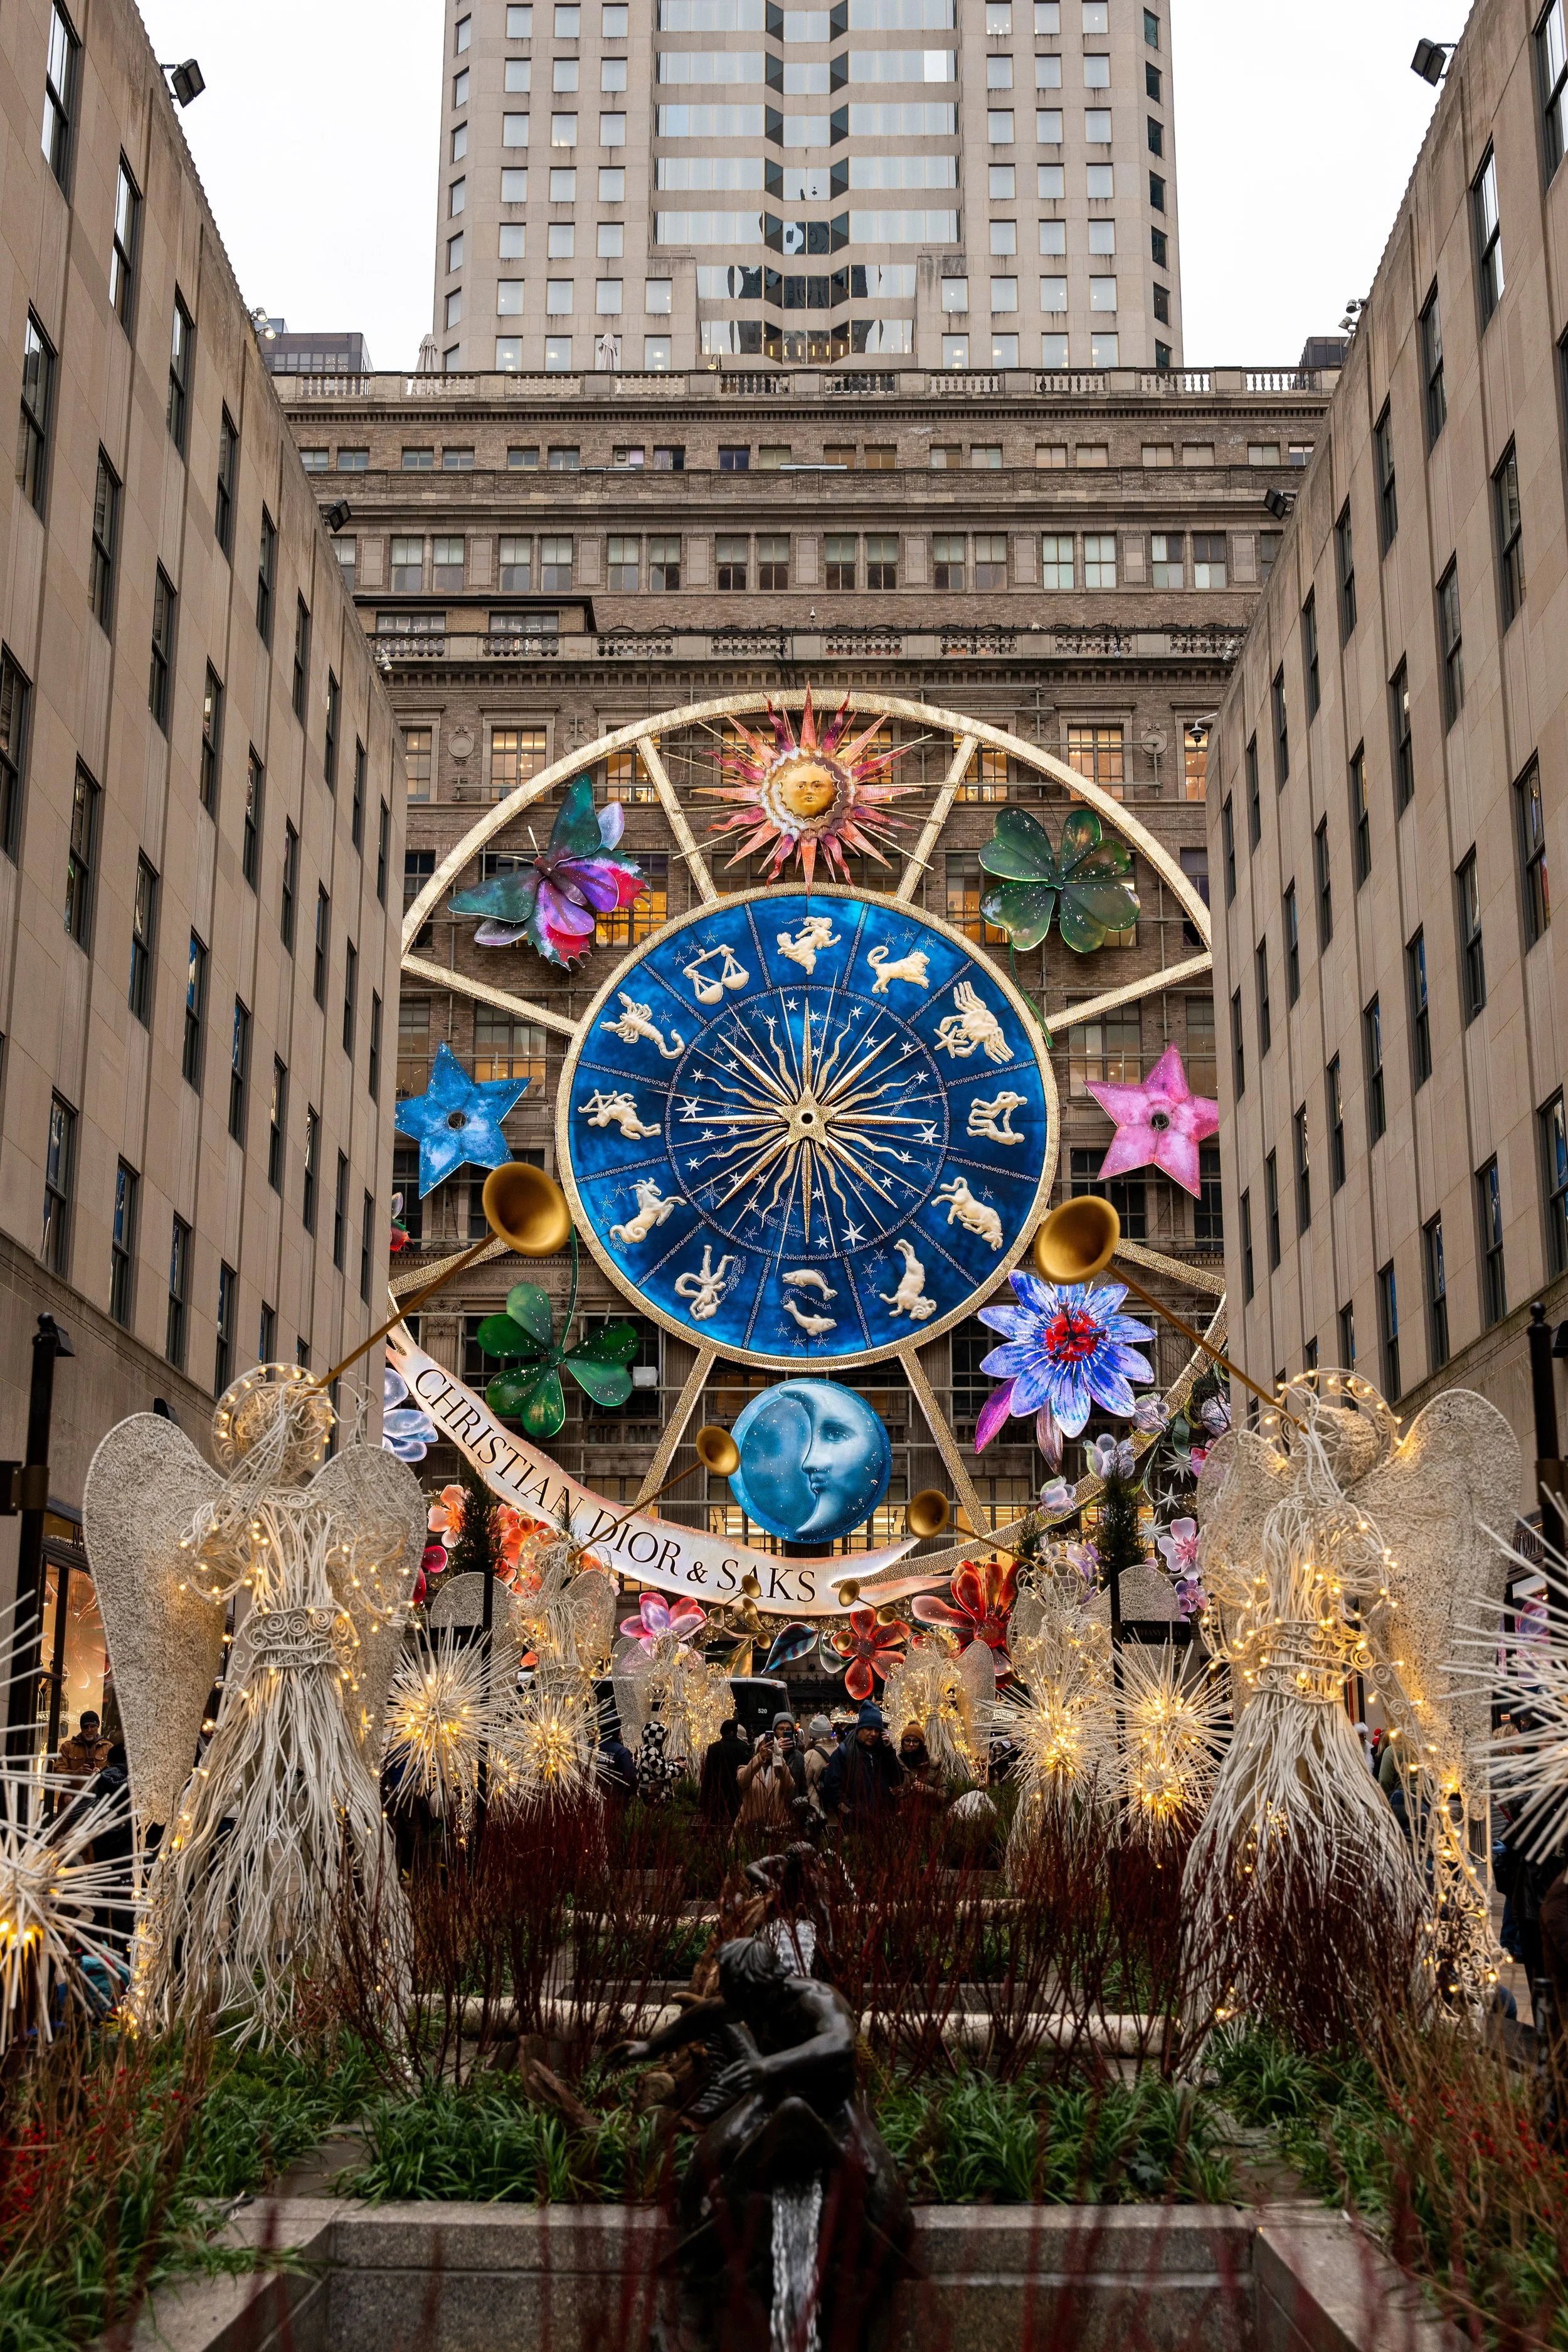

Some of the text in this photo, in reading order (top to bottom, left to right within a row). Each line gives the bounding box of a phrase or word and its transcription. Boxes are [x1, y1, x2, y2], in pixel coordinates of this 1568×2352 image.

[415, 1369, 585, 1519] CHRISTIAN
[585, 1508, 682, 1577] DIOR
[687, 1560, 707, 1584] &
